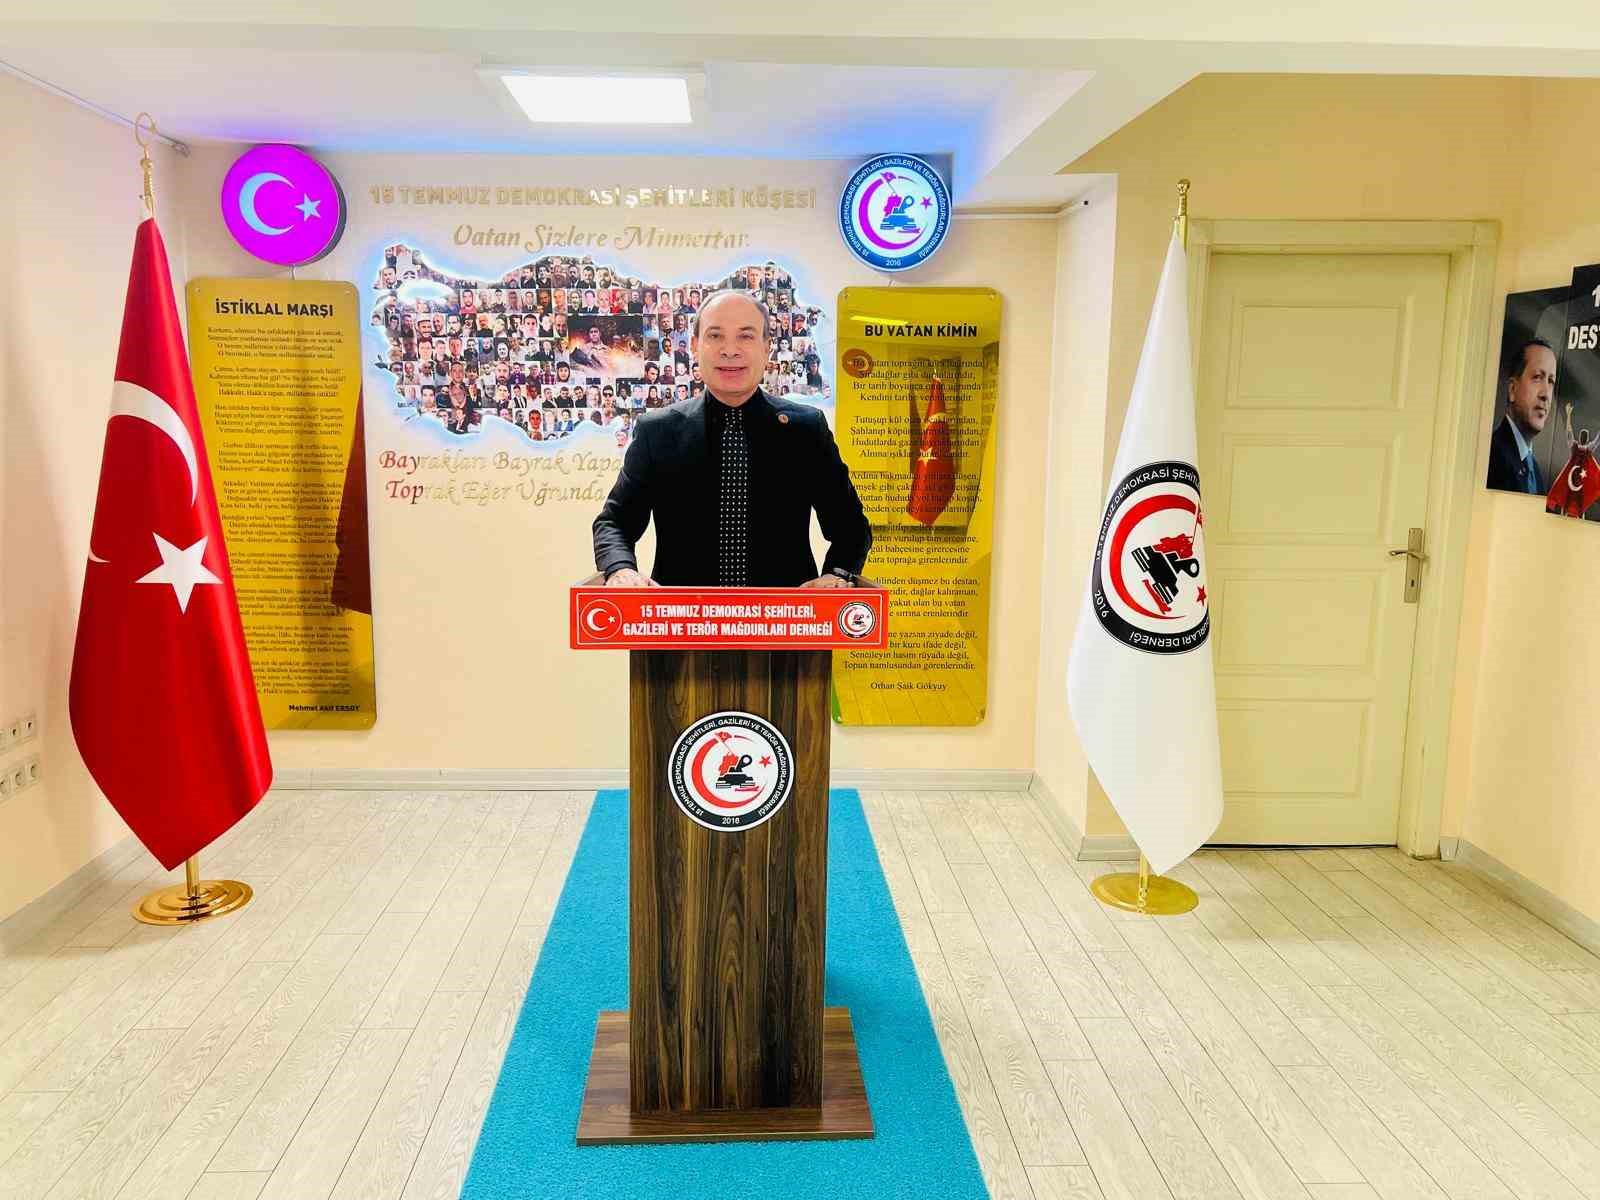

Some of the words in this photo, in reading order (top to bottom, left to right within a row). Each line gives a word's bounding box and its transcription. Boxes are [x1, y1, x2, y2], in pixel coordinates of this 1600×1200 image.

[368, 186, 394, 204] 15
[399, 187, 490, 205] TEMMUZ
[496, 185, 621, 207] DEMOKRASİ
[625, 185, 735, 208] ŞEHİTLERİ
[454, 224, 520, 247] Vatan
[524, 224, 607, 253] Sizlere
[216, 298, 283, 315] İSTİKLAL
[287, 303, 333, 318] MARŞI
[864, 325, 882, 337] BU
[886, 325, 933, 337] VATAN
[937, 322, 977, 337] KİMİN
[492, 451, 570, 475] Bayrak
[572, 451, 624, 477] Yapa
[1113, 467, 1169, 505] DEMOKRASİ
[640, 605, 653, 618] 15
[655, 605, 700, 618] TEMMUZ
[702, 603, 763, 619] DEMOKRASİ
[765, 604, 817, 621] ŞEHİTLERİ,
[1094, 590, 1109, 618] 2016
[623, 620, 669, 636] GAZİLERİ
[671, 623, 685, 636] VE
[687, 621, 718, 637] TERÖR
[720, 621, 787, 637] MAĞDURLARI
[789, 621, 833, 637] DERNEĞİ
[1129, 631, 1180, 647] DERNEĞİ
[870, 682, 894, 690] Orhan
[750, 722, 760, 731] VE
[758, 727, 778, 746] TERÖR
[676, 744, 689, 784] DEMOKRASİ
[677, 784, 697, 811] TEMMUZ
